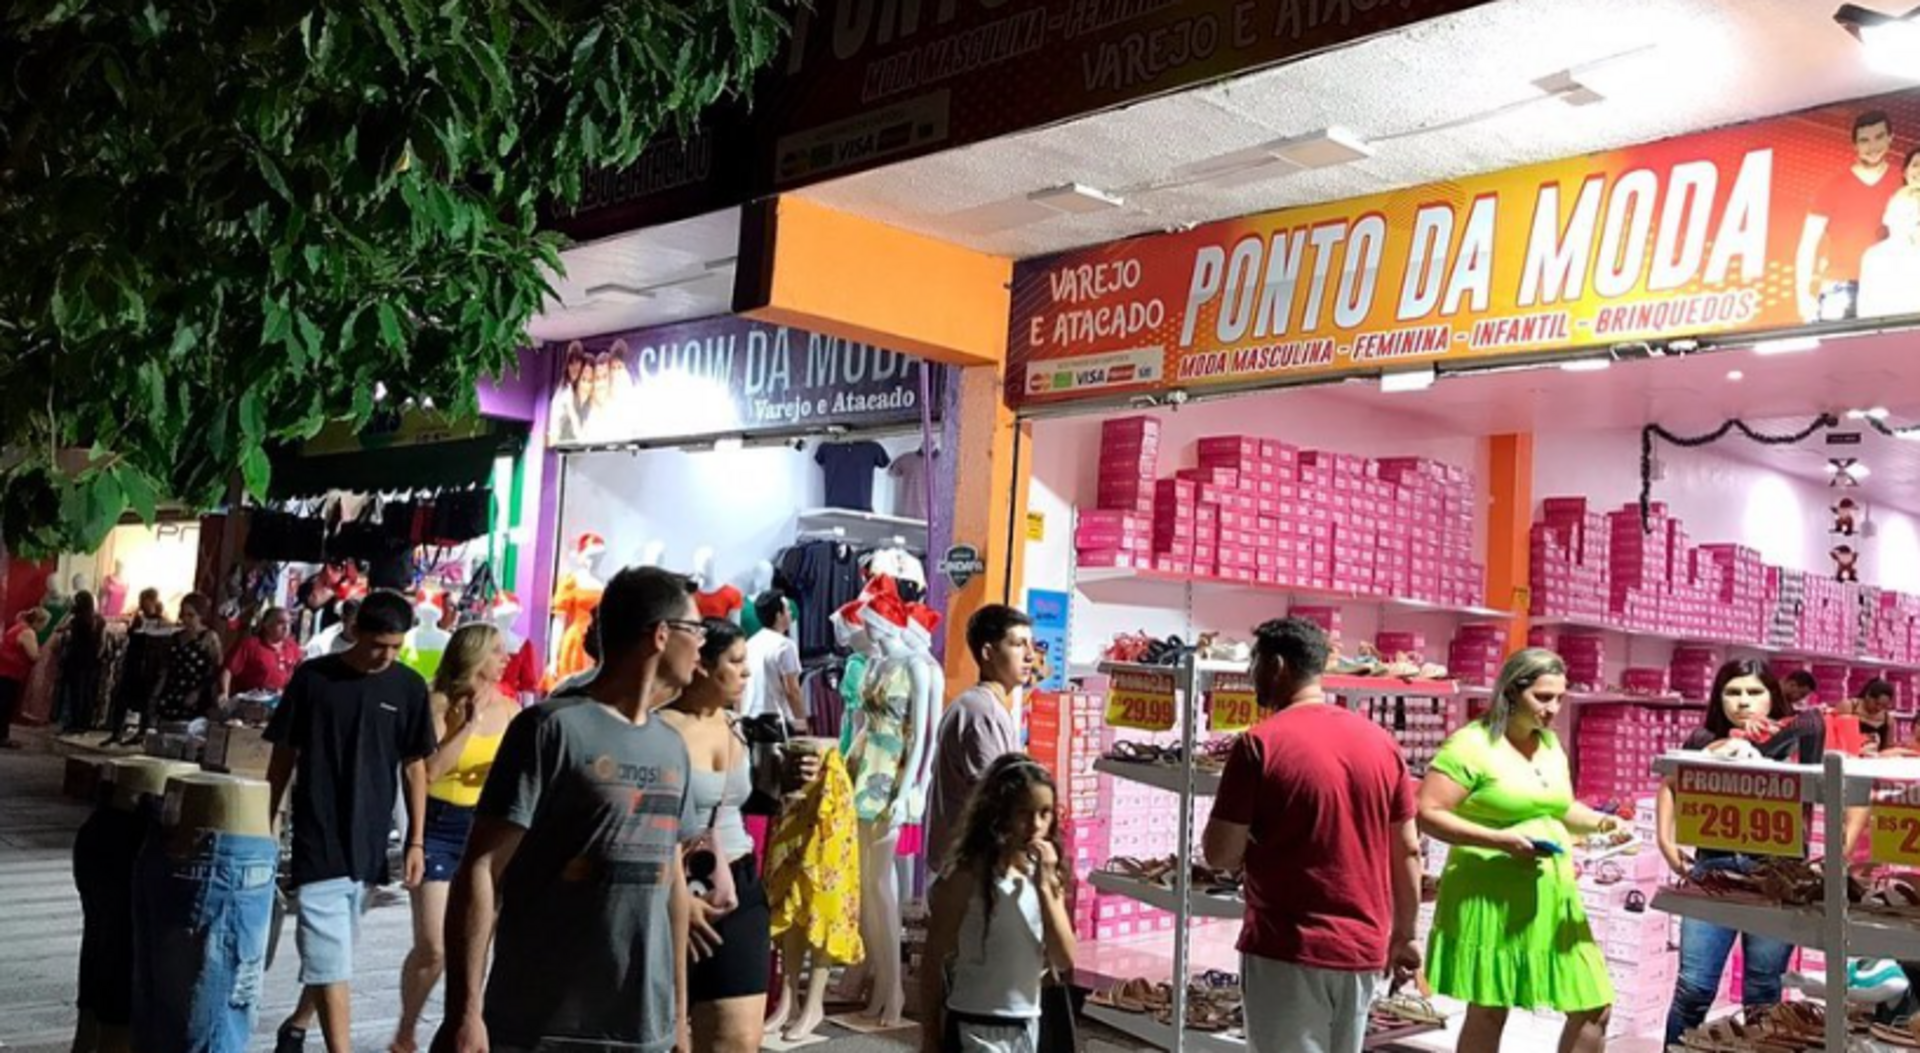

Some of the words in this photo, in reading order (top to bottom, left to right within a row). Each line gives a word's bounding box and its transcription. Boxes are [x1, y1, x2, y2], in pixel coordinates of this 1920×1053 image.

[1082, 14, 1219, 92] VAREJO
[1232, 2, 1258, 48] E
[1179, 211, 1387, 347] PONTO
[1396, 192, 1498, 321] DA
[1516, 148, 1773, 307] MODA
[1051, 258, 1141, 304] VAREJO
[1030, 316, 1045, 346] E
[1052, 299, 1164, 347] ATACADO
[1179, 353, 1227, 378] MODA
[1231, 340, 1333, 372] MASCULINA
[1352, 326, 1450, 360] FEMININA
[1472, 314, 1568, 347] INFANTIL
[1595, 290, 1755, 335] BRINQUEDOS
[744, 327, 790, 395] DA
[1076, 368, 1105, 386] VISA
[754, 396, 812, 424] Varejo
[817, 396, 828, 409] e
[831, 384, 916, 414] Atacado
[1121, 697, 1172, 725] 29,99
[1682, 769, 1795, 799] PROMOÇÃO
[1681, 803, 1699, 817] R$
[1699, 803, 1795, 846] 29,99
